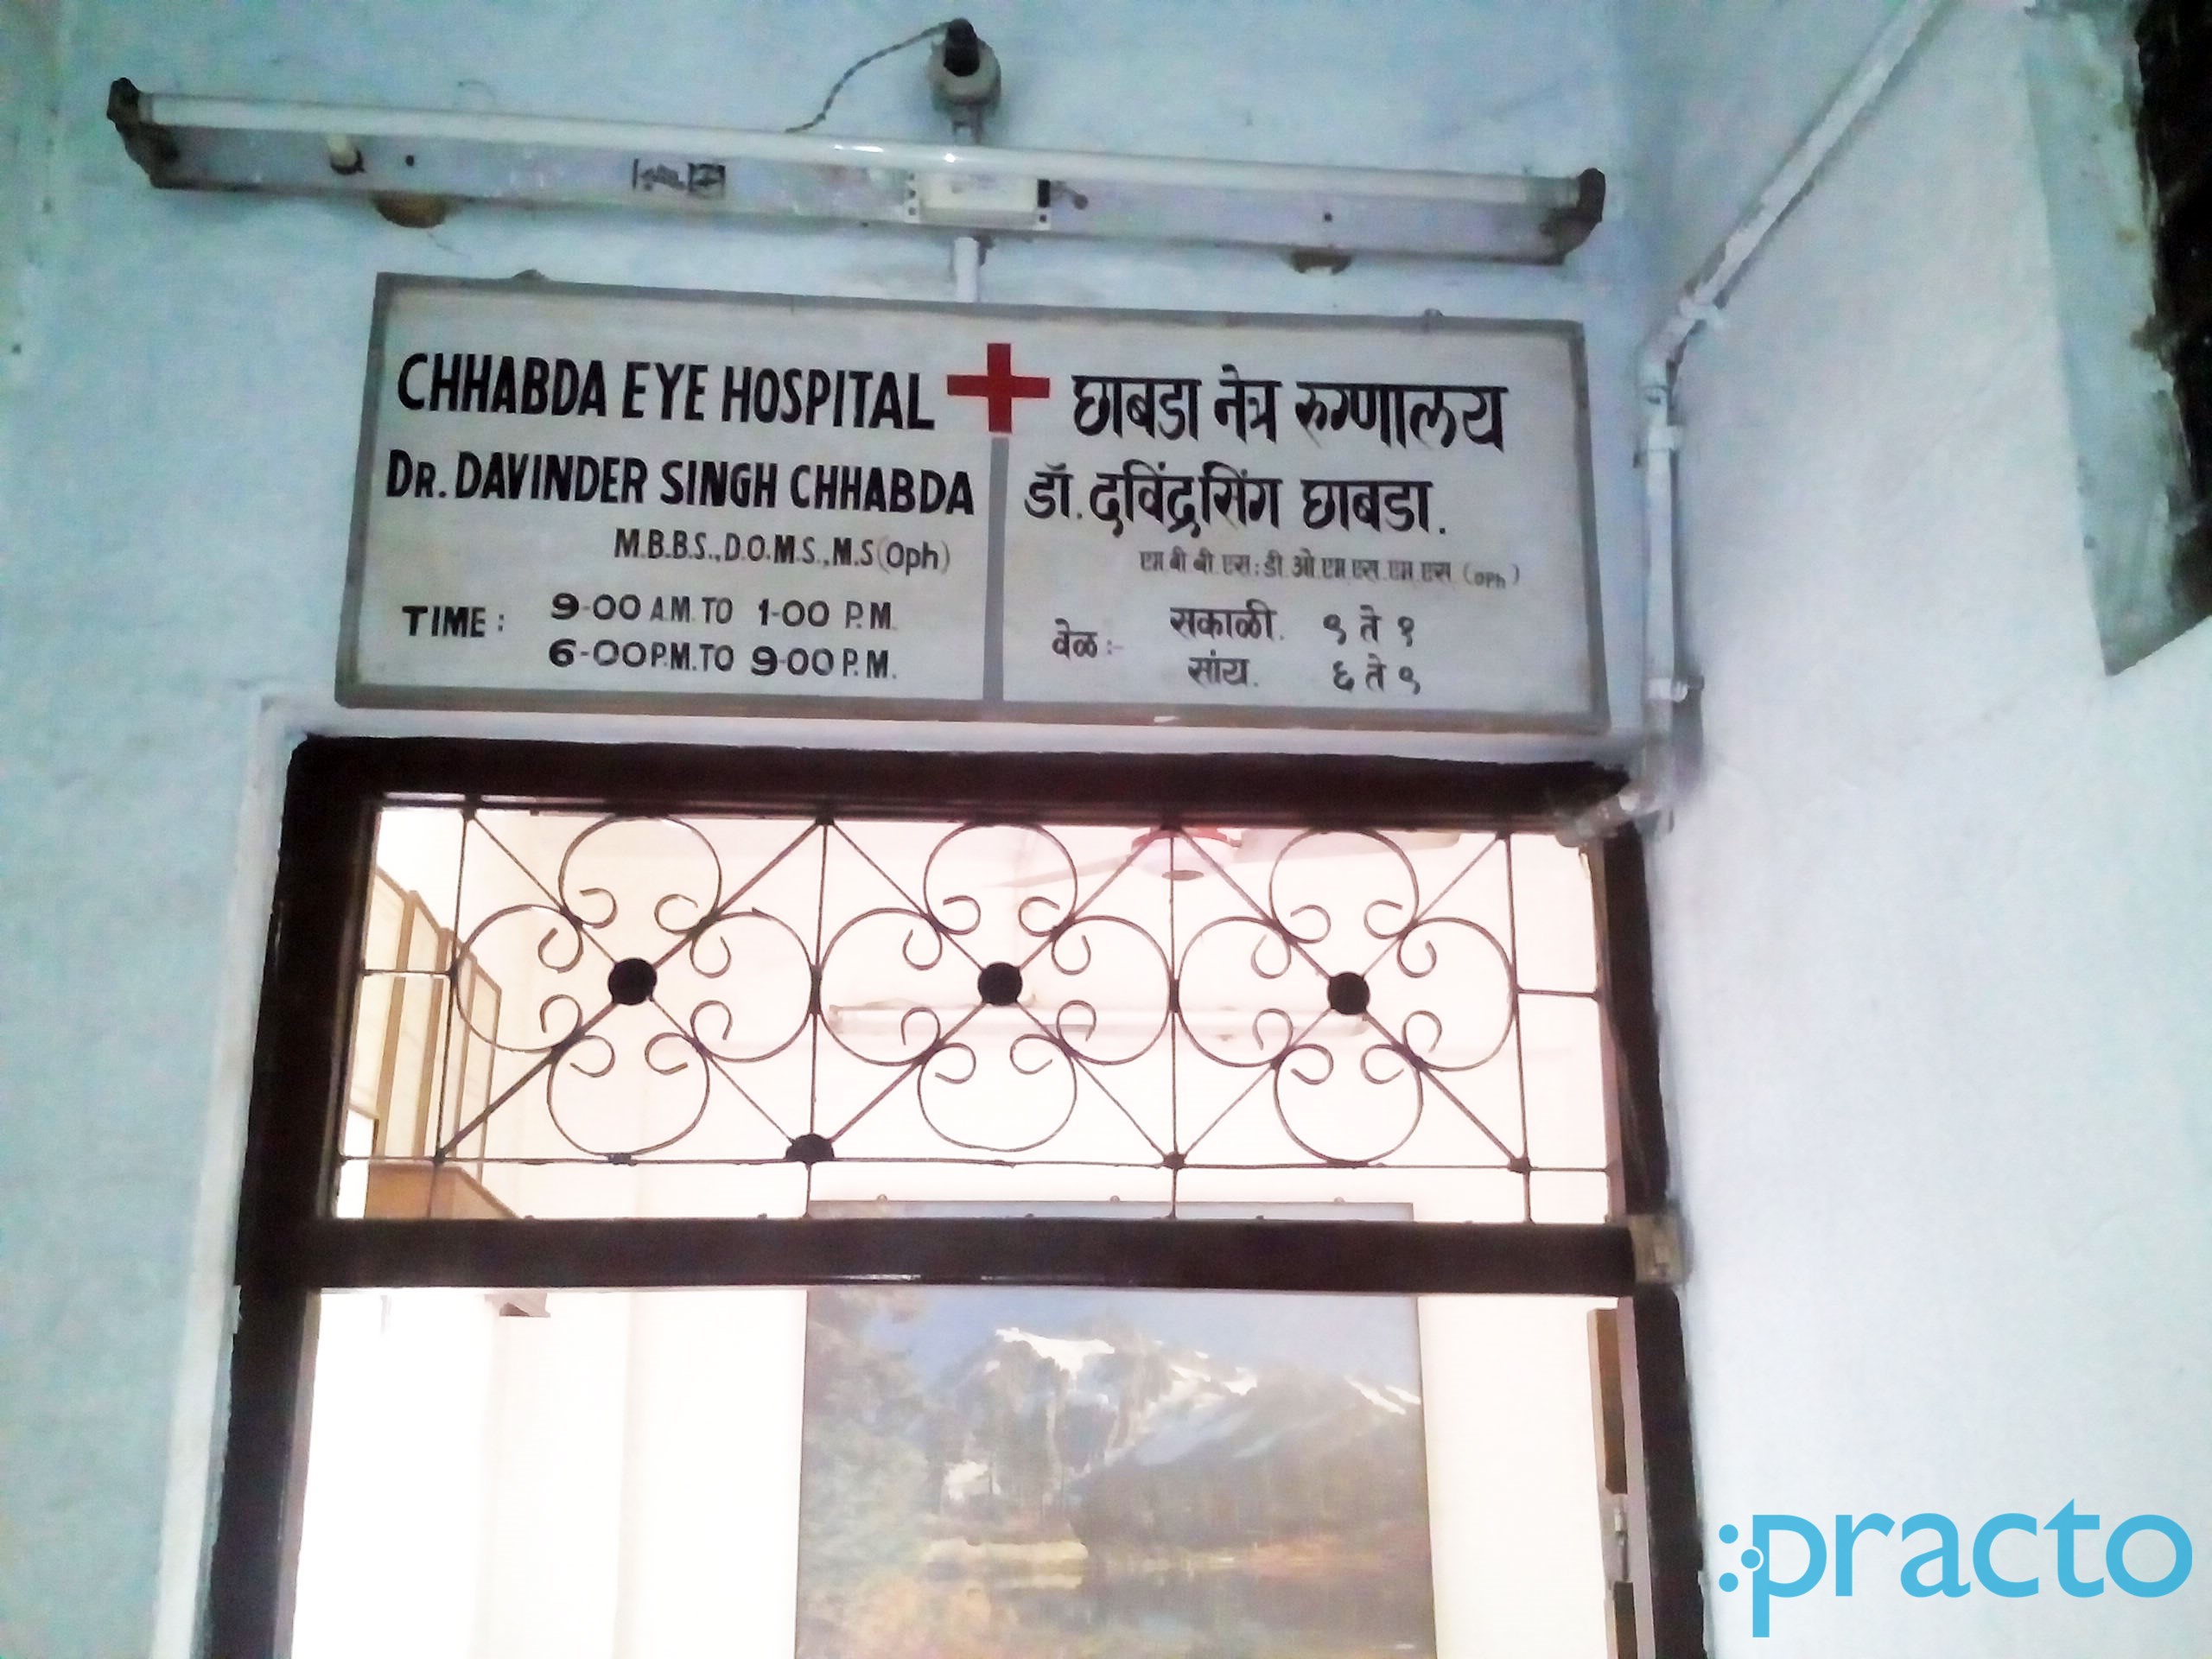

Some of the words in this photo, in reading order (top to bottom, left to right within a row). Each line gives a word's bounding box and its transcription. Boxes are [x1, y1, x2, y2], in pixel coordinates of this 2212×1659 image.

[397, 353, 607, 417] CHHABDA
[622, 361, 710, 422] EYE
[721, 364, 936, 430] HOSPITAL
[1071, 374, 1203, 442] छाबडा
[1213, 363, 1284, 444] नेत्र
[1294, 380, 1510, 454] रुग्णालय
[455, 451, 648, 505] DAVINDER
[660, 459, 778, 508] SINGH
[790, 463, 975, 516] CHHABDA
[550, 592, 642, 620] 9-00
[758, 598, 830, 627] 1-00
[1359, 603, 1382, 644] ते
[750, 645, 835, 677] 9-00
[1364, 652, 1388, 692] ते
